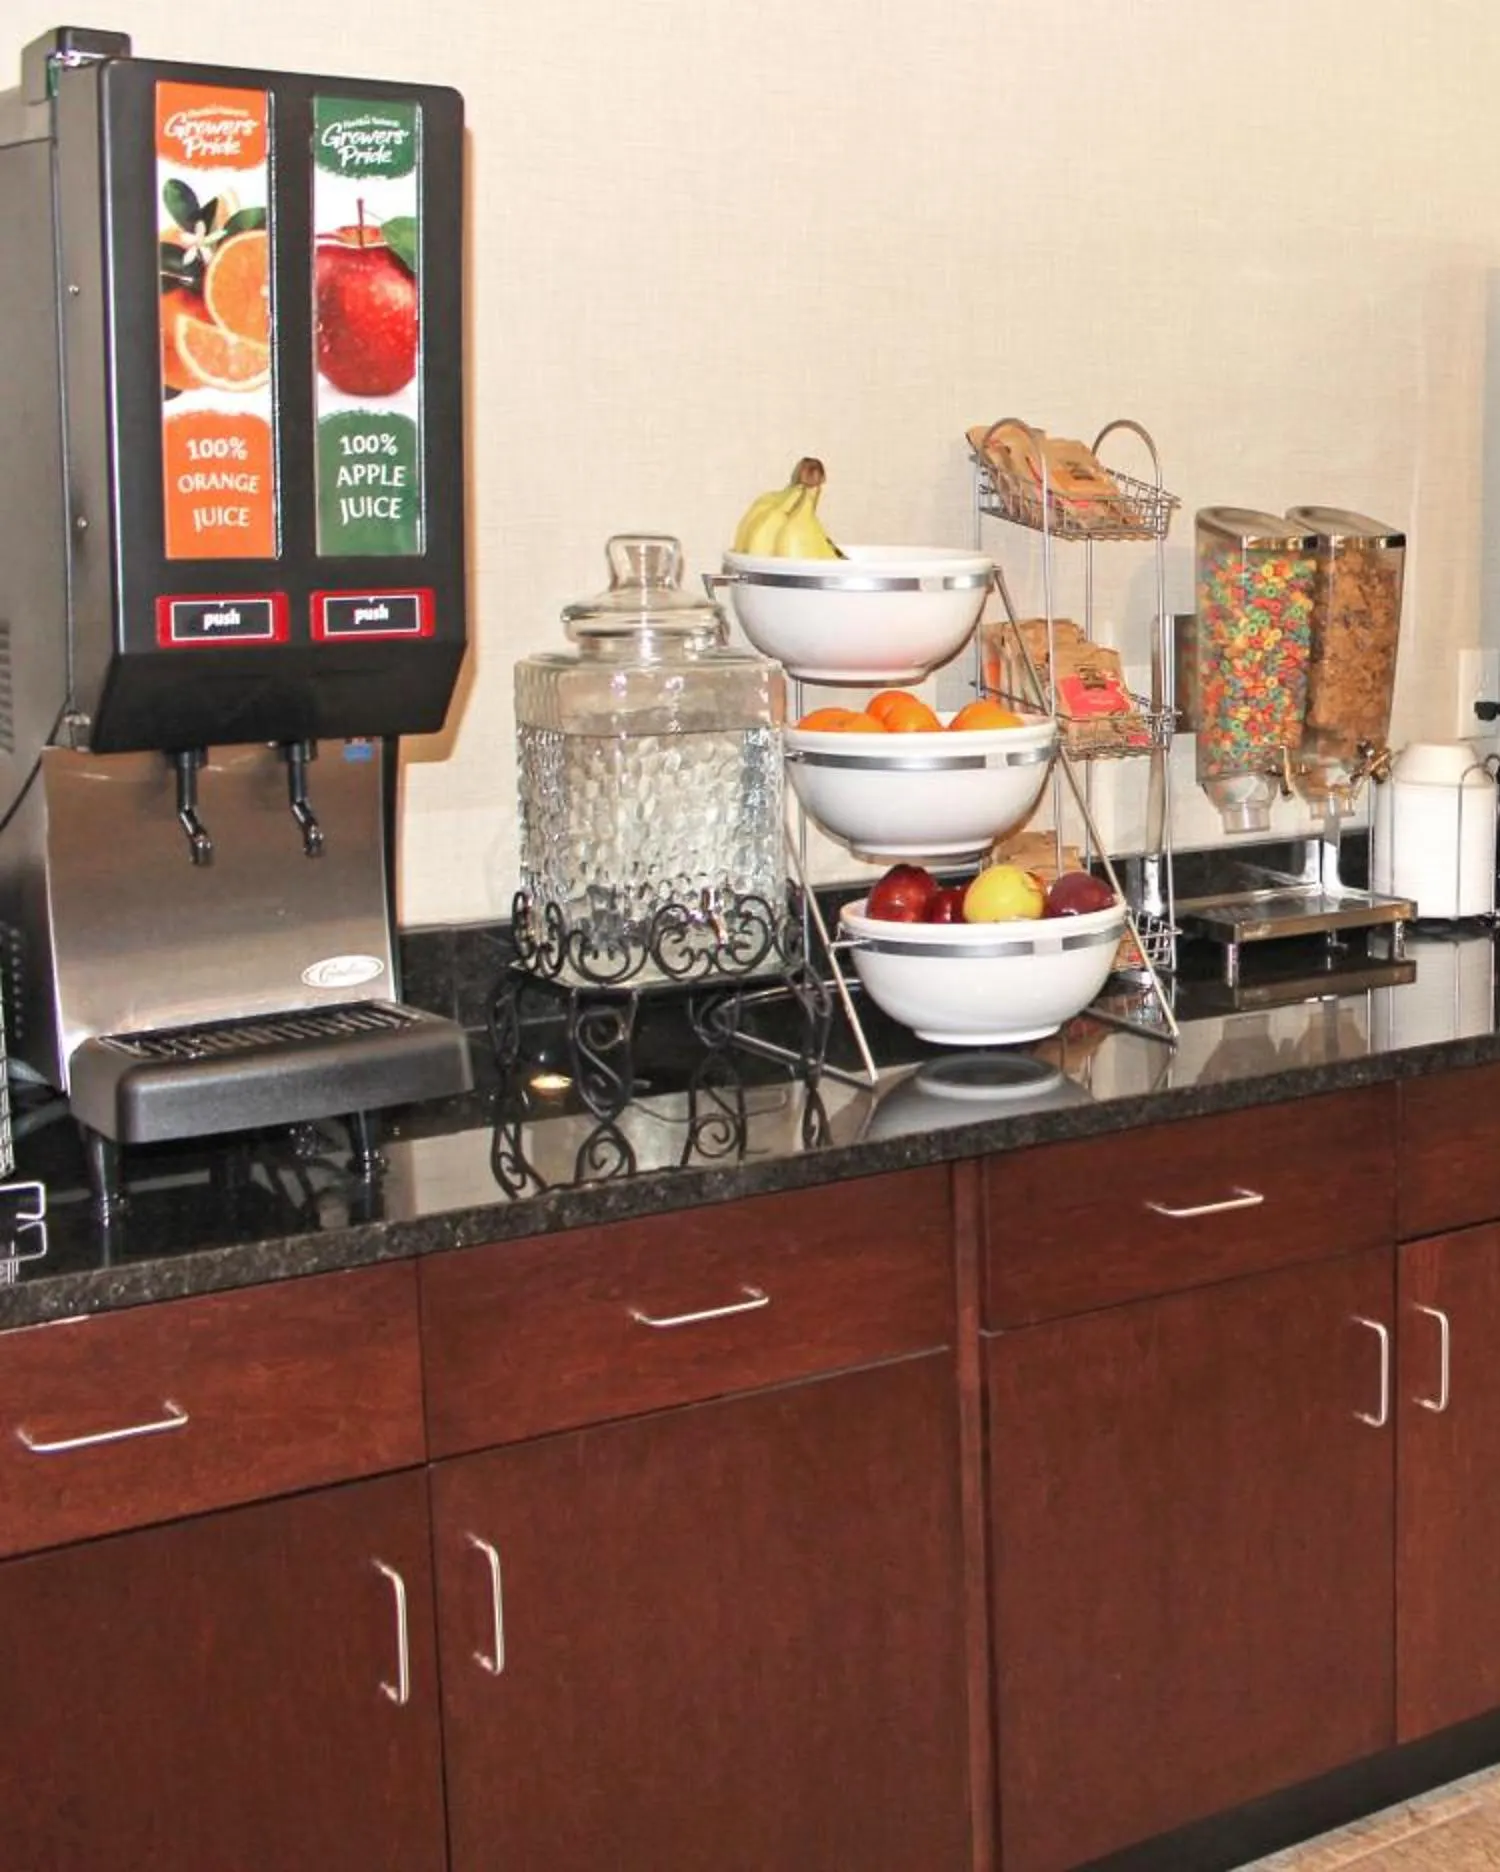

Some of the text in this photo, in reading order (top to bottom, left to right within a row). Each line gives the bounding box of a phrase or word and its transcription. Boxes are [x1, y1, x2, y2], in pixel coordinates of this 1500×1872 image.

[163, 111, 259, 138] Growers
[321, 122, 409, 148] Growers
[181, 135, 242, 159] Pride
[337, 144, 393, 168] Pride
[186, 436, 248, 461] 100%
[339, 433, 398, 456] 100%
[177, 471, 260, 494] ORANGE
[335, 464, 406, 488] APPLE
[193, 506, 250, 532] JUICE
[339, 497, 402, 526] JUICE
[203, 608, 241, 631] push
[354, 604, 389, 624] push
